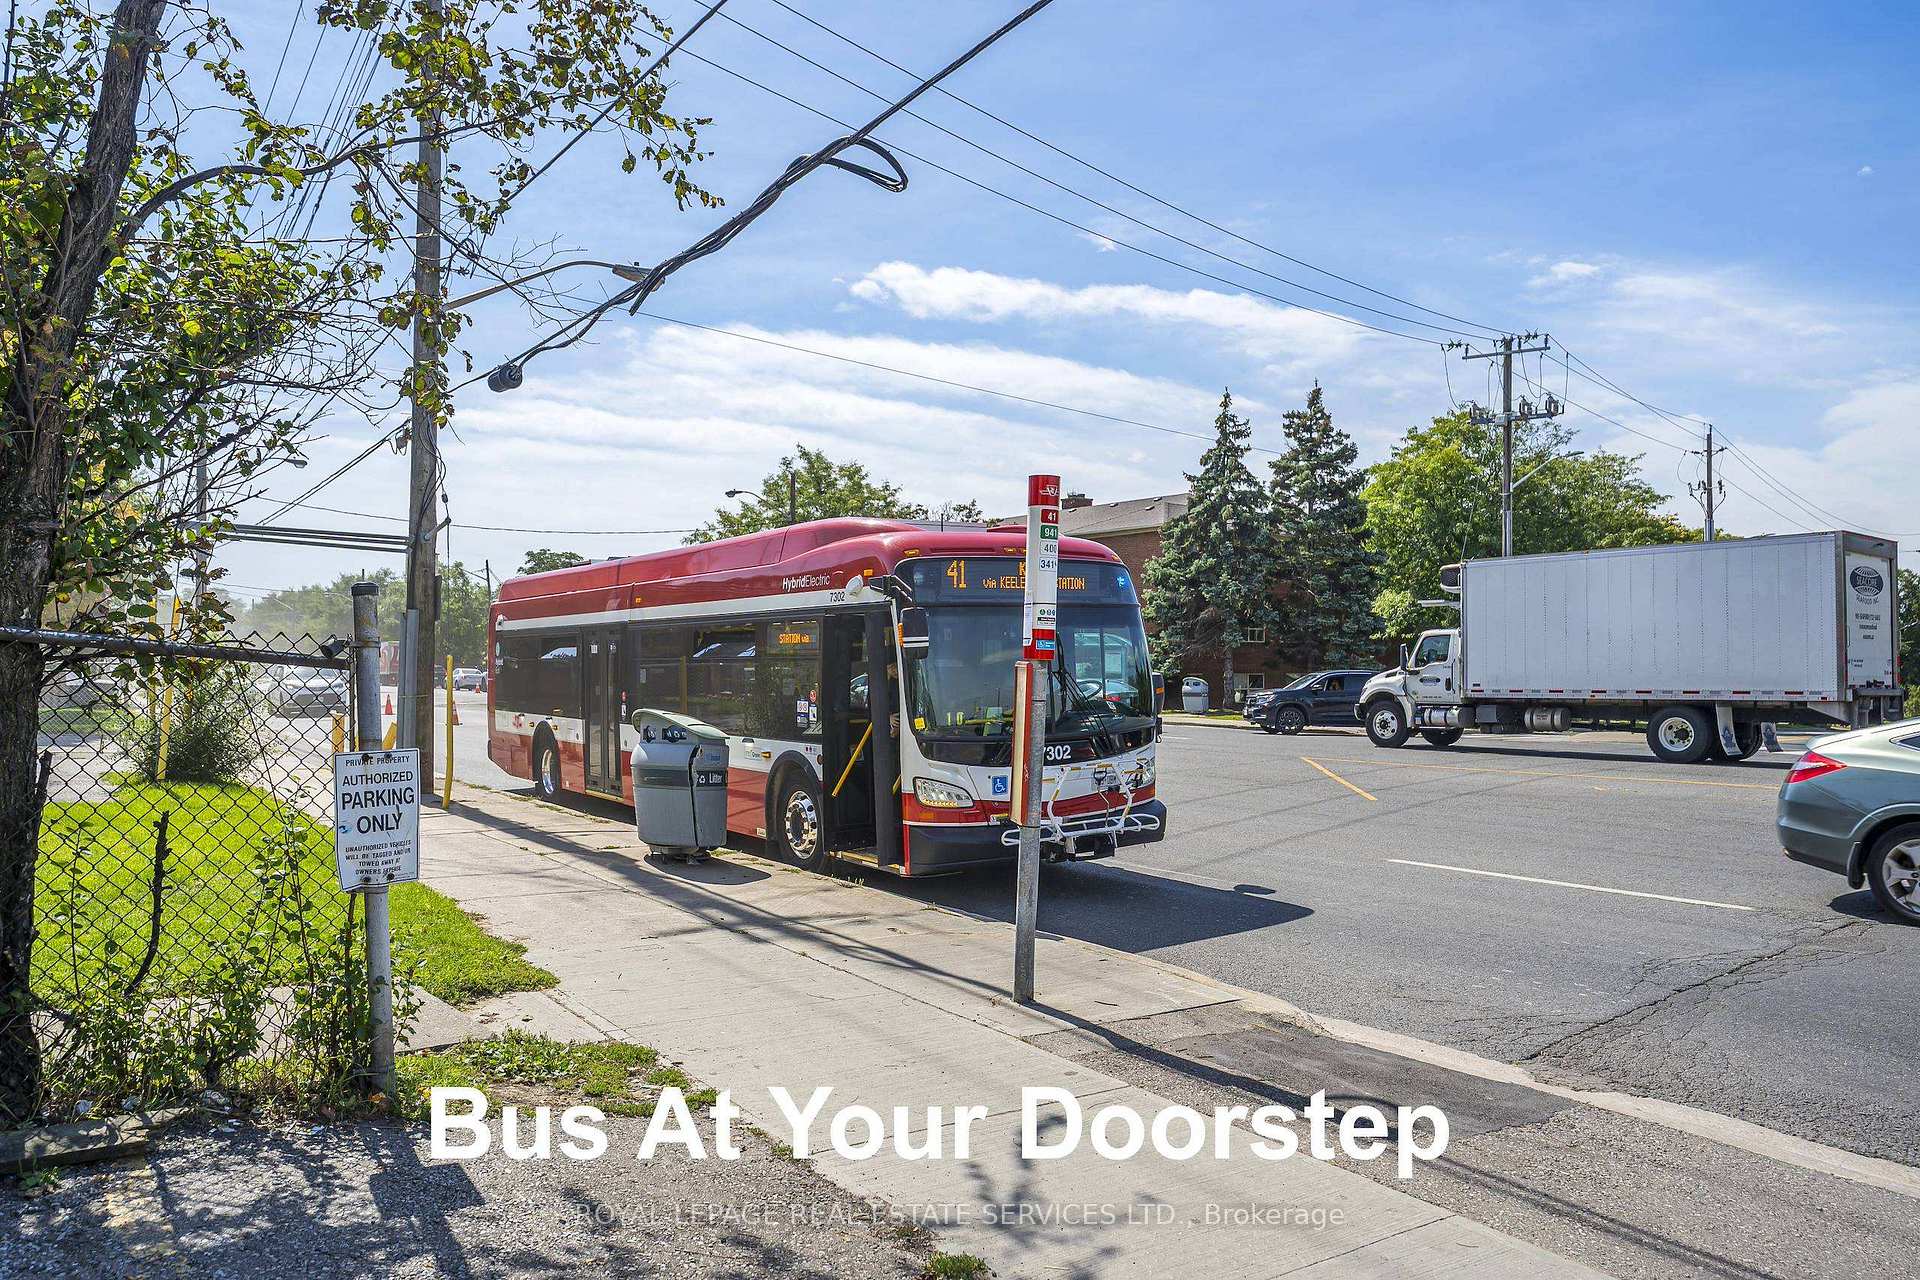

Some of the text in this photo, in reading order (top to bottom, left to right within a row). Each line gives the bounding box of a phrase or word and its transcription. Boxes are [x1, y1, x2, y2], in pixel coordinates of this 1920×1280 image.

[1047, 512, 1056, 521] 41
[1044, 527, 1057, 537] 941
[946, 559, 967, 589] 41
[782, 573, 830, 592] HybridElectric
[983, 576, 1085, 590] via KEELE TATION
[830, 592, 845, 602] 7302
[779, 633, 800, 644] STATION
[345, 755, 410, 767] PRIVATE PROPERTY
[342, 771, 413, 786] AUTHORIZED
[709, 773, 722, 783] Litter
[341, 787, 414, 810] PARKING
[356, 812, 403, 834] ONLY
[345, 843, 388, 852] UNAUTHORIZED
